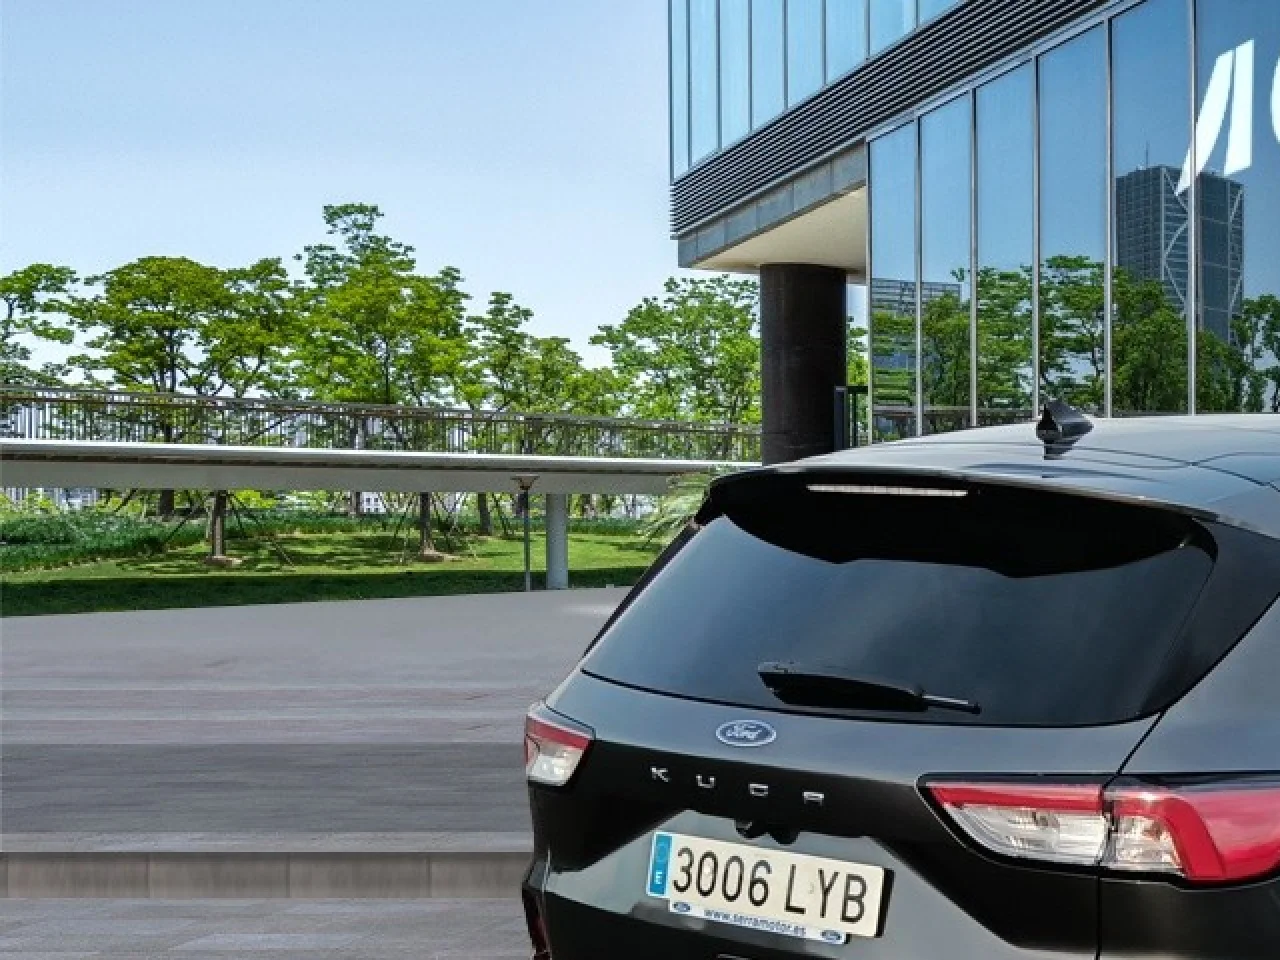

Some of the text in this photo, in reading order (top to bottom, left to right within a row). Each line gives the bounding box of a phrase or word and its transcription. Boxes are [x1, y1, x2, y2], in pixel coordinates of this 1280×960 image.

[723, 720, 766, 741] Ford
[651, 767, 825, 804] KUGA
[653, 871, 663, 884] E
[673, 847, 868, 924] 3006 LYB
